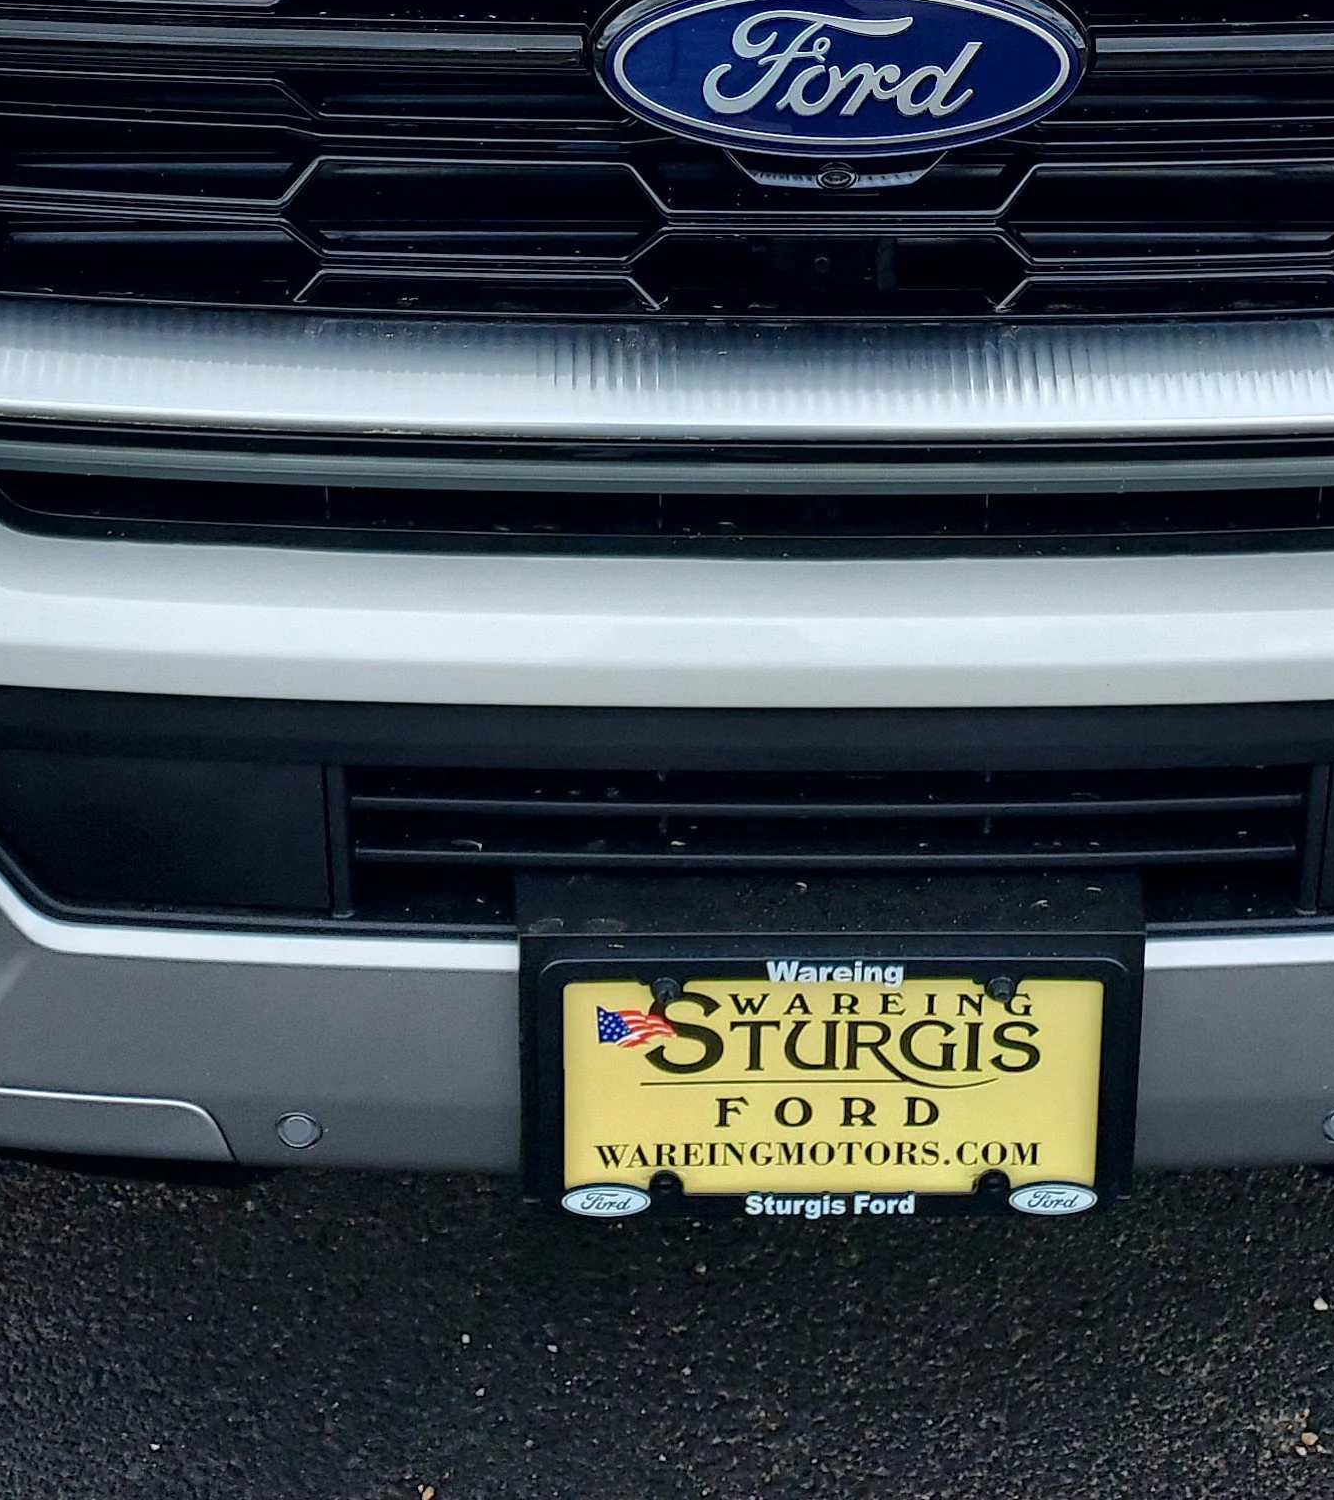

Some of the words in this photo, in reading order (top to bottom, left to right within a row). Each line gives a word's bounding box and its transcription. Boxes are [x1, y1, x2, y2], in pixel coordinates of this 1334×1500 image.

[703, 10, 983, 117] Ford
[766, 961, 904, 987] Wareing
[728, 992, 1033, 1017] WAREING
[644, 991, 1041, 1088] STURGIS
[714, 1096, 940, 1128] FORD
[594, 1141, 1042, 1169] WAREINGMOTORS.COM
[580, 1192, 631, 1213] Ford
[744, 1194, 846, 1220] Sturgis
[853, 1194, 916, 1215] Ford
[1027, 1190, 1078, 1210] Ford
